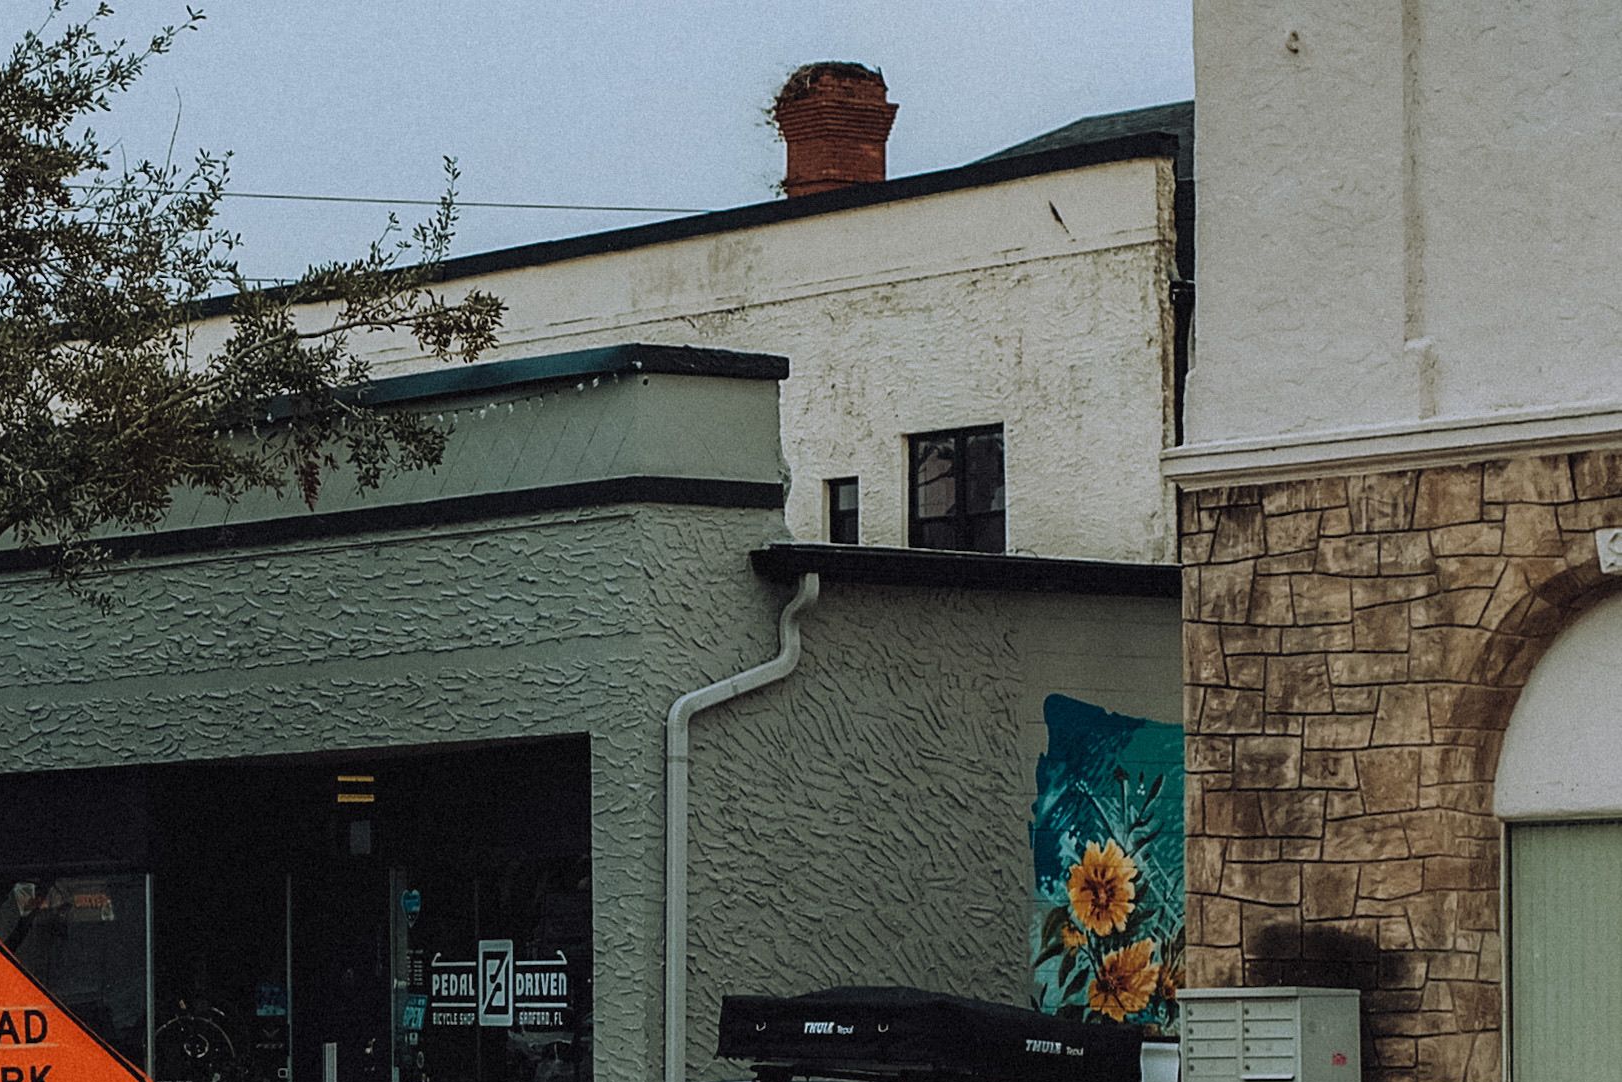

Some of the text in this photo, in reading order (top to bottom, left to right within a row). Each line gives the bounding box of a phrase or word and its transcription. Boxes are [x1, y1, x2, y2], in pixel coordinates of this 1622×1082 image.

[432, 972, 567, 996] PEDAL DRIVEN
[433, 1012, 475, 1025] BICYCLE SHOP
[554, 1011, 563, 1025] FL
[804, 1021, 835, 1034] THULE
[1025, 1039, 1062, 1054] THULE
